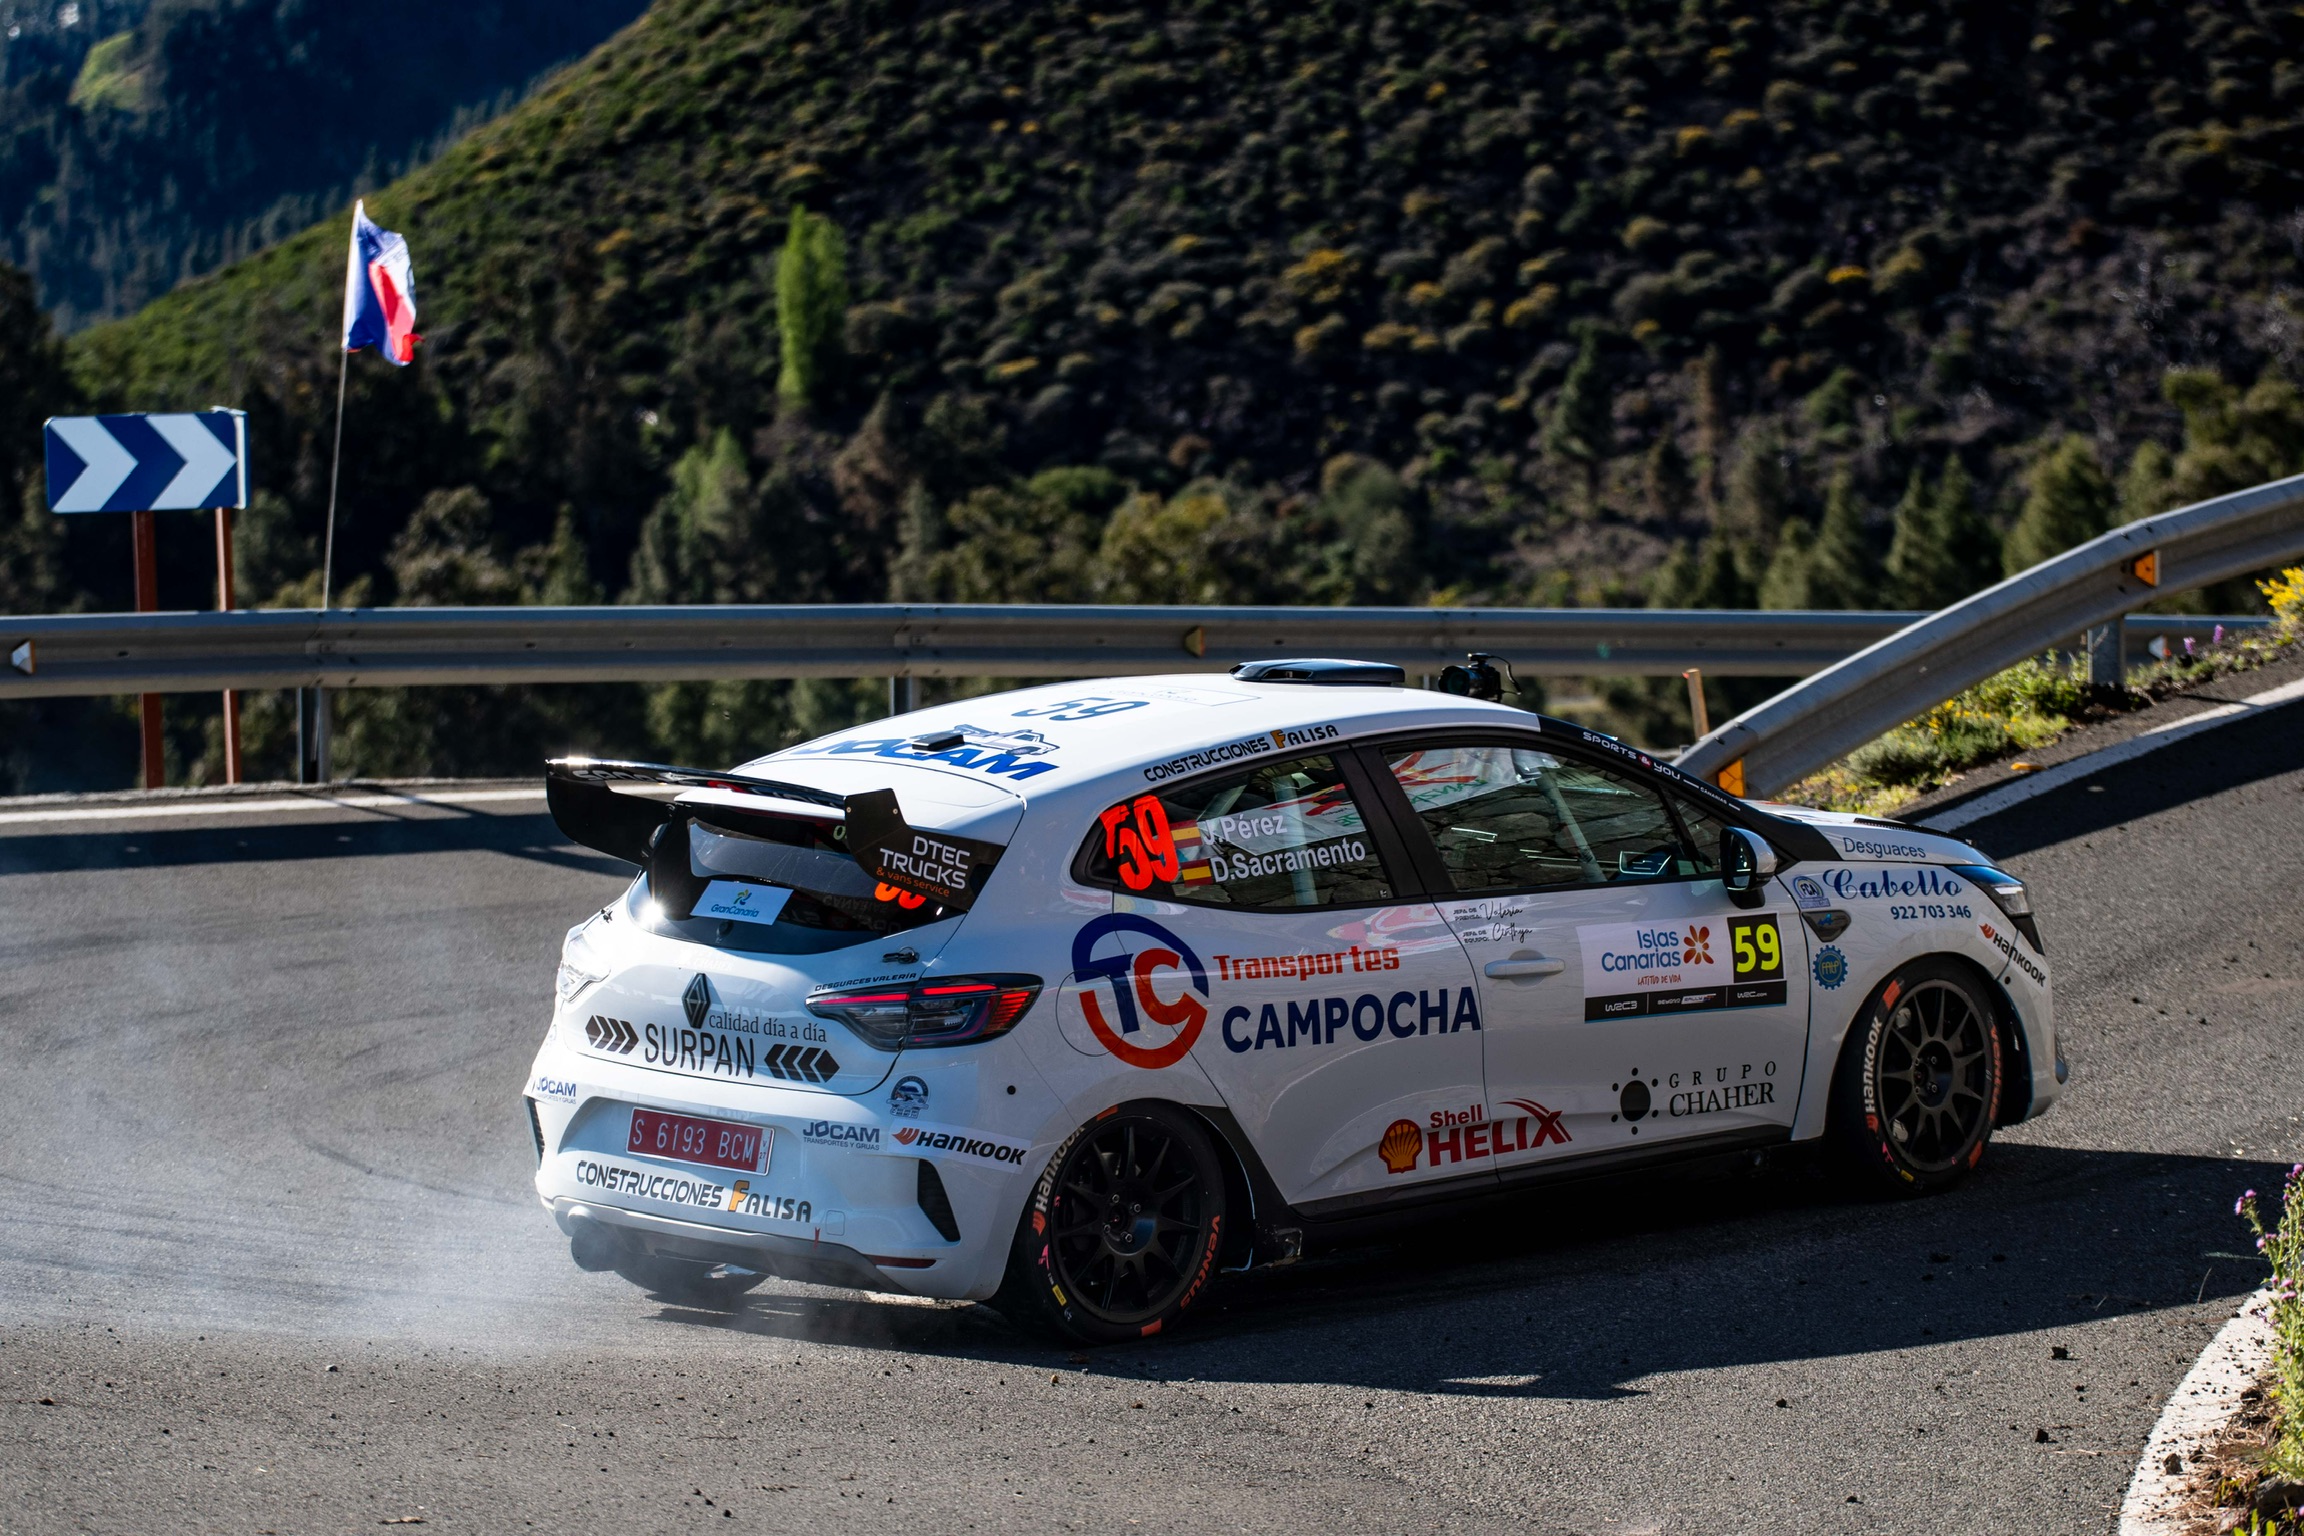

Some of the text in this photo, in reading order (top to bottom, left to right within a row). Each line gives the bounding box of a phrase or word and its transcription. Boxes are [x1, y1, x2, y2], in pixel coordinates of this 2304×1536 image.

[1010, 697, 1151, 721] 59
[1143, 724, 1339, 782] CONSTRUCCIONES FALISA
[1582, 731, 1637, 760] SPORTS
[1653, 763, 1681, 780] YOU
[1699, 786, 1728, 805] CANARIAS
[1099, 794, 1180, 891] 59
[1201, 813, 1288, 846] J.Pérez
[912, 835, 971, 870] DTEC
[1211, 837, 1366, 883] D.Sacramento
[1843, 837, 1926, 858] Desguaces
[875, 866, 885, 876] &
[887, 871, 912, 885] vans
[913, 876, 950, 897] service
[879, 847, 966, 890] TRUCKS
[1822, 868, 1962, 899] Cabello
[1799, 879, 1818, 896] FCA
[1890, 904, 1972, 920] 922 703 346
[1637, 929, 1679, 949] Islas
[1735, 923, 1780, 973] 59
[1213, 945, 1400, 981] Transportes
[1601, 949, 1681, 972] Canarias
[814, 977, 871, 992] DESGUACES
[1637, 974, 1682, 986] LATITUD DE VIDA
[1222, 986, 1482, 1054] CAMPOCHA
[1605, 1000, 1638, 1012] WRC3
[708, 1012, 827, 1043] calidad día a día
[645, 1023, 755, 1078] SURPAN
[535, 1077, 577, 1098] JOCAM
[1669, 1082, 1775, 1117] CHAHER
[1430, 1103, 1483, 1129] Shell
[632, 1119, 755, 1163] S 6193 BCM
[803, 1121, 880, 1143] JOCAM
[803, 1136, 849, 1147] TRANSPORTES
[855, 1142, 880, 1151] GRUAS
[1427, 1098, 1573, 1168] HELIX
[576, 1159, 812, 1223] CONSTRUCCIONES FALISA
